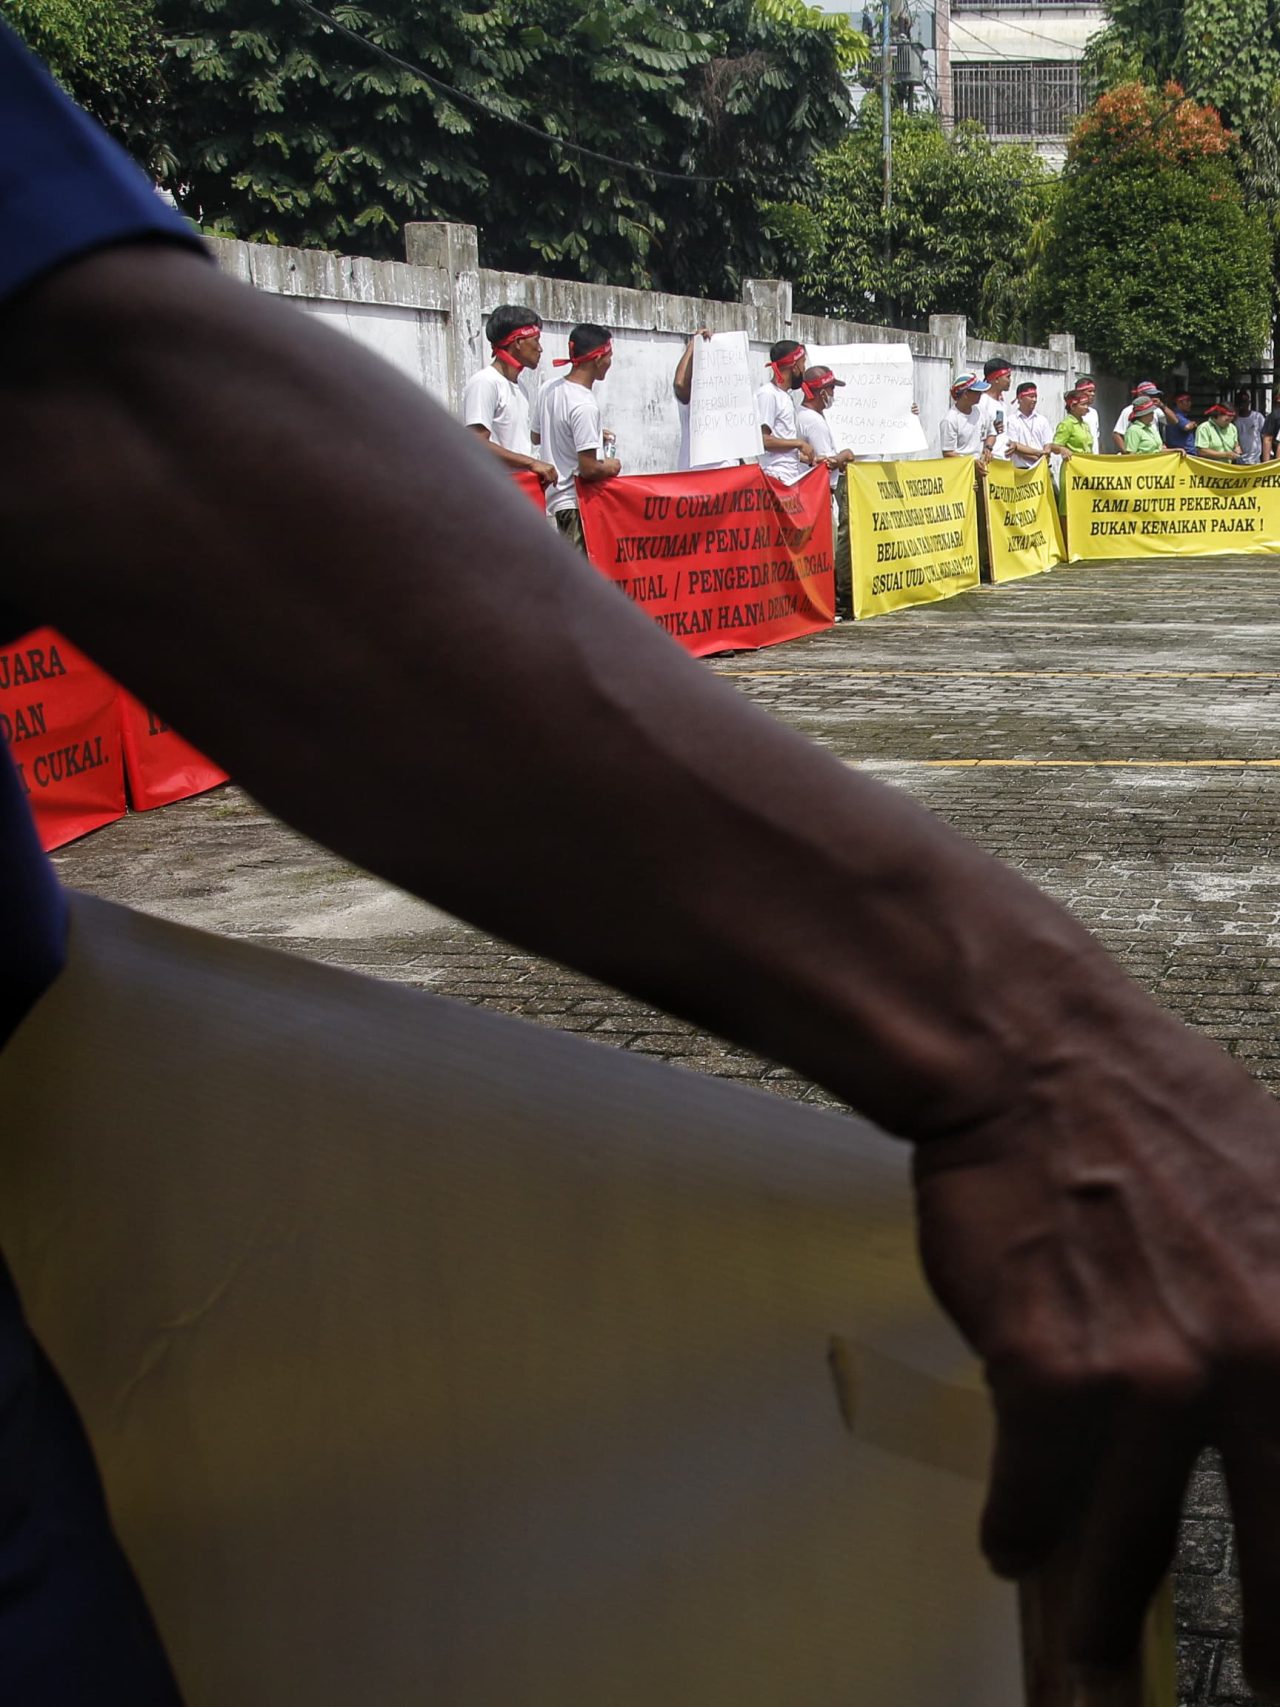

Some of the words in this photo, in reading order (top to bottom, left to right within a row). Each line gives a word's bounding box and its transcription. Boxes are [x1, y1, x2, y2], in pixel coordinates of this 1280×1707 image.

[833, 396, 878, 409] ENTANG
[1071, 475, 1132, 491] NAIKKAN
[1137, 475, 1175, 490] CUKAI
[1189, 473, 1251, 490] NAIKKAN
[642, 495, 672, 521] UU
[674, 491, 729, 519] CUKAI
[924, 503, 953, 524] SELAMA
[952, 501, 966, 521] INI
[1091, 498, 1129, 513] KAMI
[1132, 498, 1175, 513] BUTUH
[1180, 496, 1261, 513] PEKERJAAN,
[1090, 520, 1137, 536] BUKAN
[1141, 519, 1207, 535] KENAIKAN
[1211, 518, 1255, 533] PAJAK
[614, 531, 704, 564] HUKUMAN
[673, 571, 681, 602] /
[872, 570, 903, 595] SSUAI
[905, 567, 925, 588] UUD
[33, 736, 110, 789] CUKAI.
